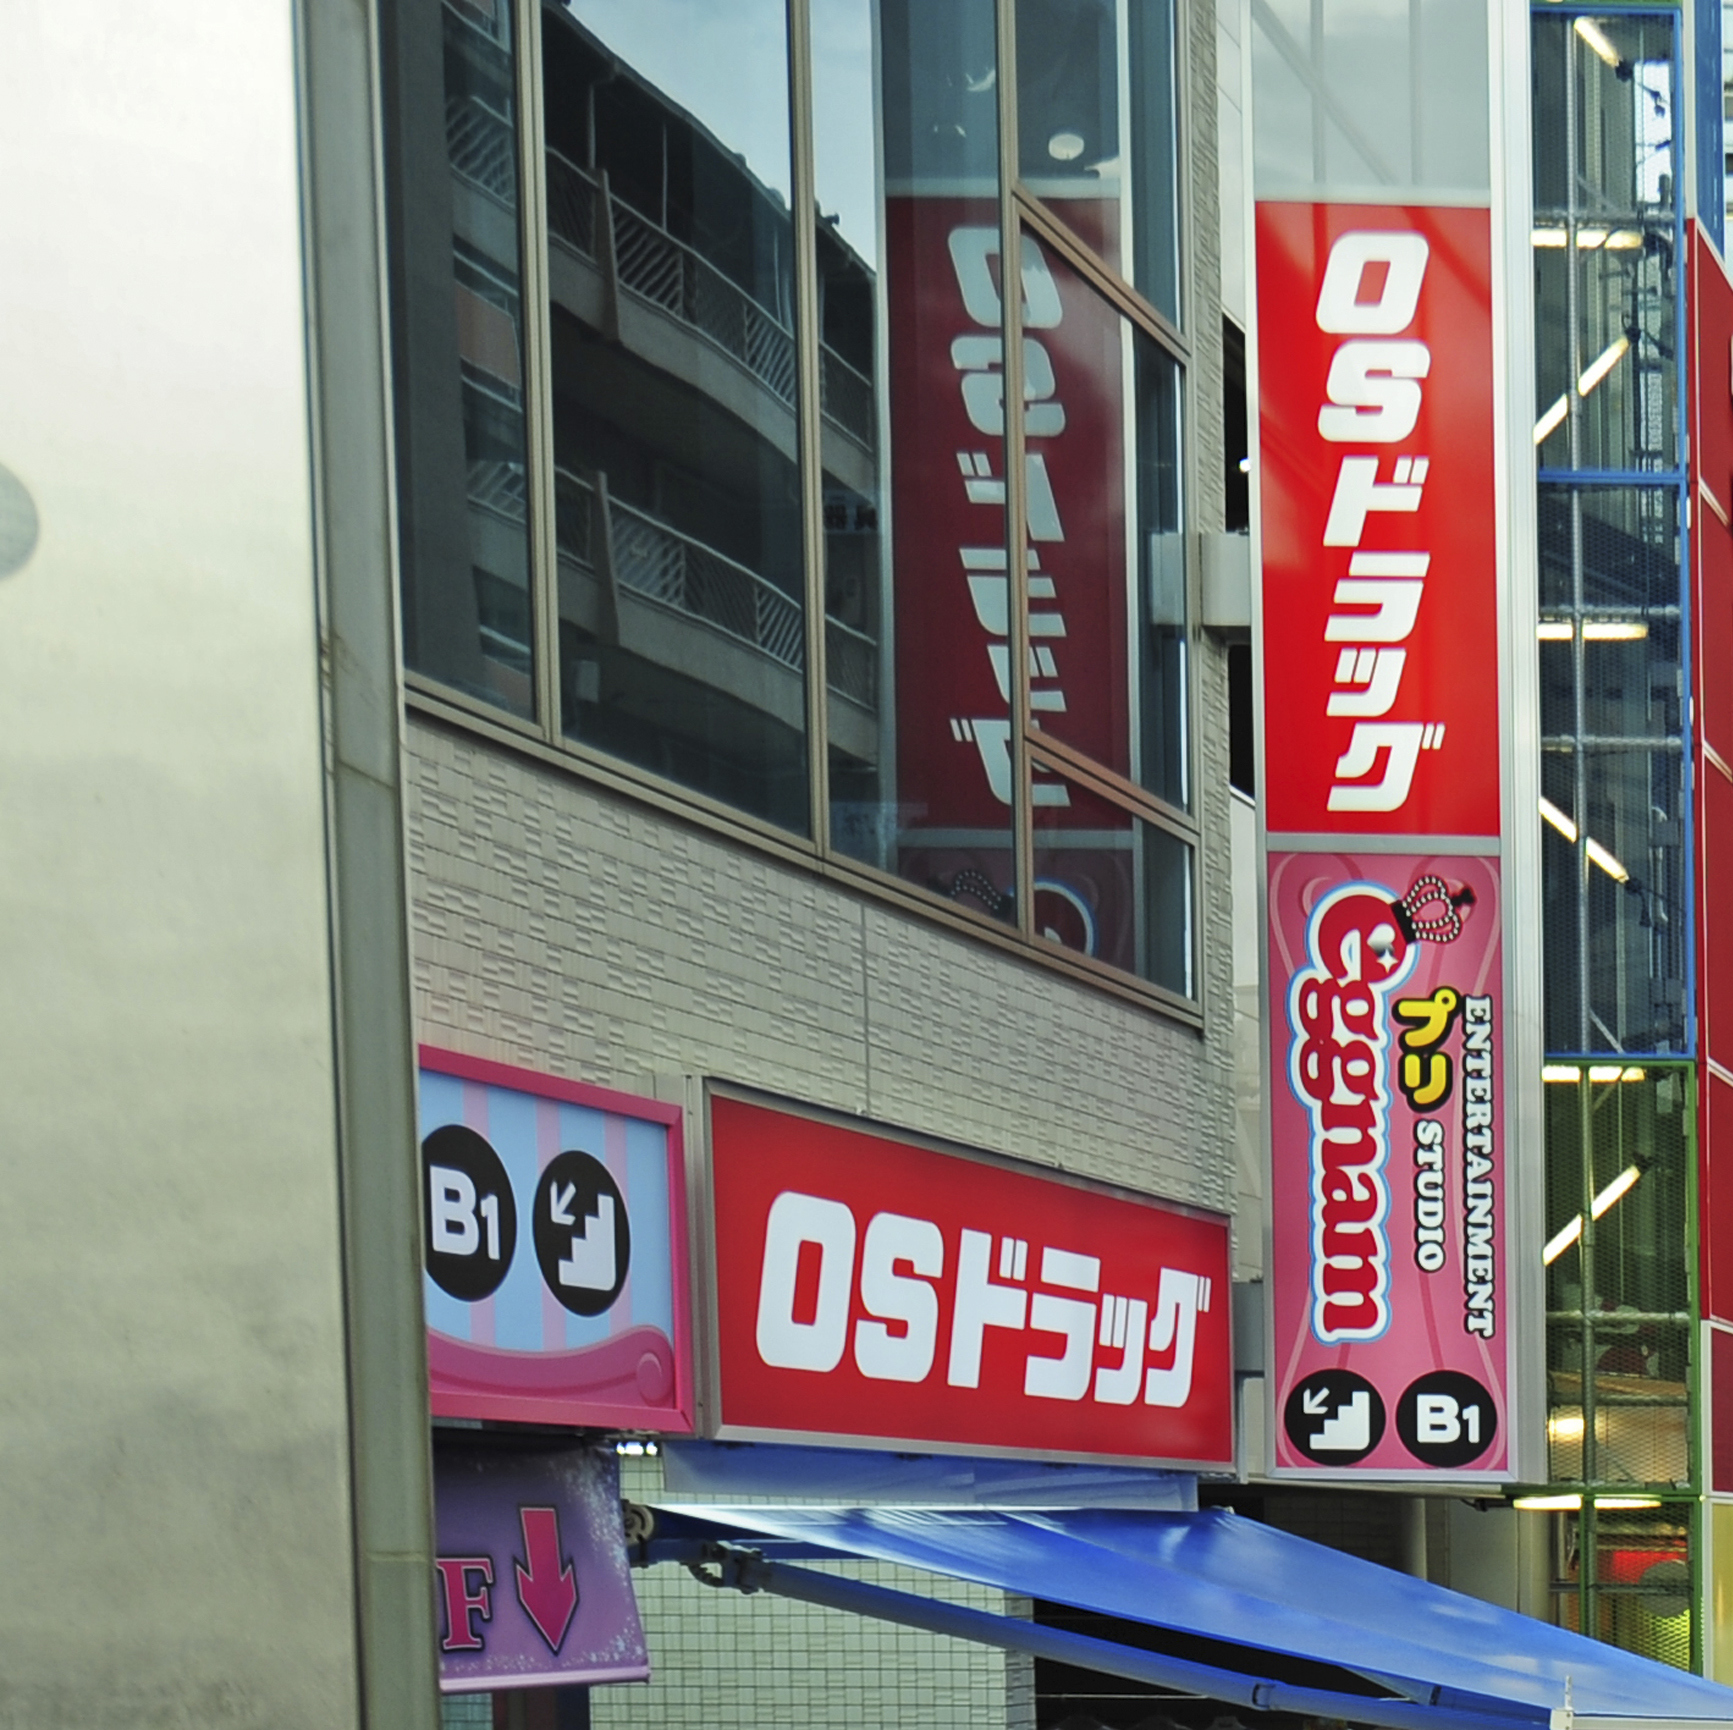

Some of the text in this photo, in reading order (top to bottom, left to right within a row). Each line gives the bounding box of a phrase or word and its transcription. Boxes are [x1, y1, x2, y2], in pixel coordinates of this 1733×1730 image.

[1315, 231, 1446, 813] OSドラッグ
[429, 1164, 500, 1261] B1
[1298, 888, 1408, 1337] eggnam
[1396, 988, 1458, 1272] プリ STUDIO
[1464, 995, 1493, 1338] ENTERTAINMENT
[755, 1190, 1212, 1409] OSドラッグ
[1416, 1395, 1481, 1445] B1
